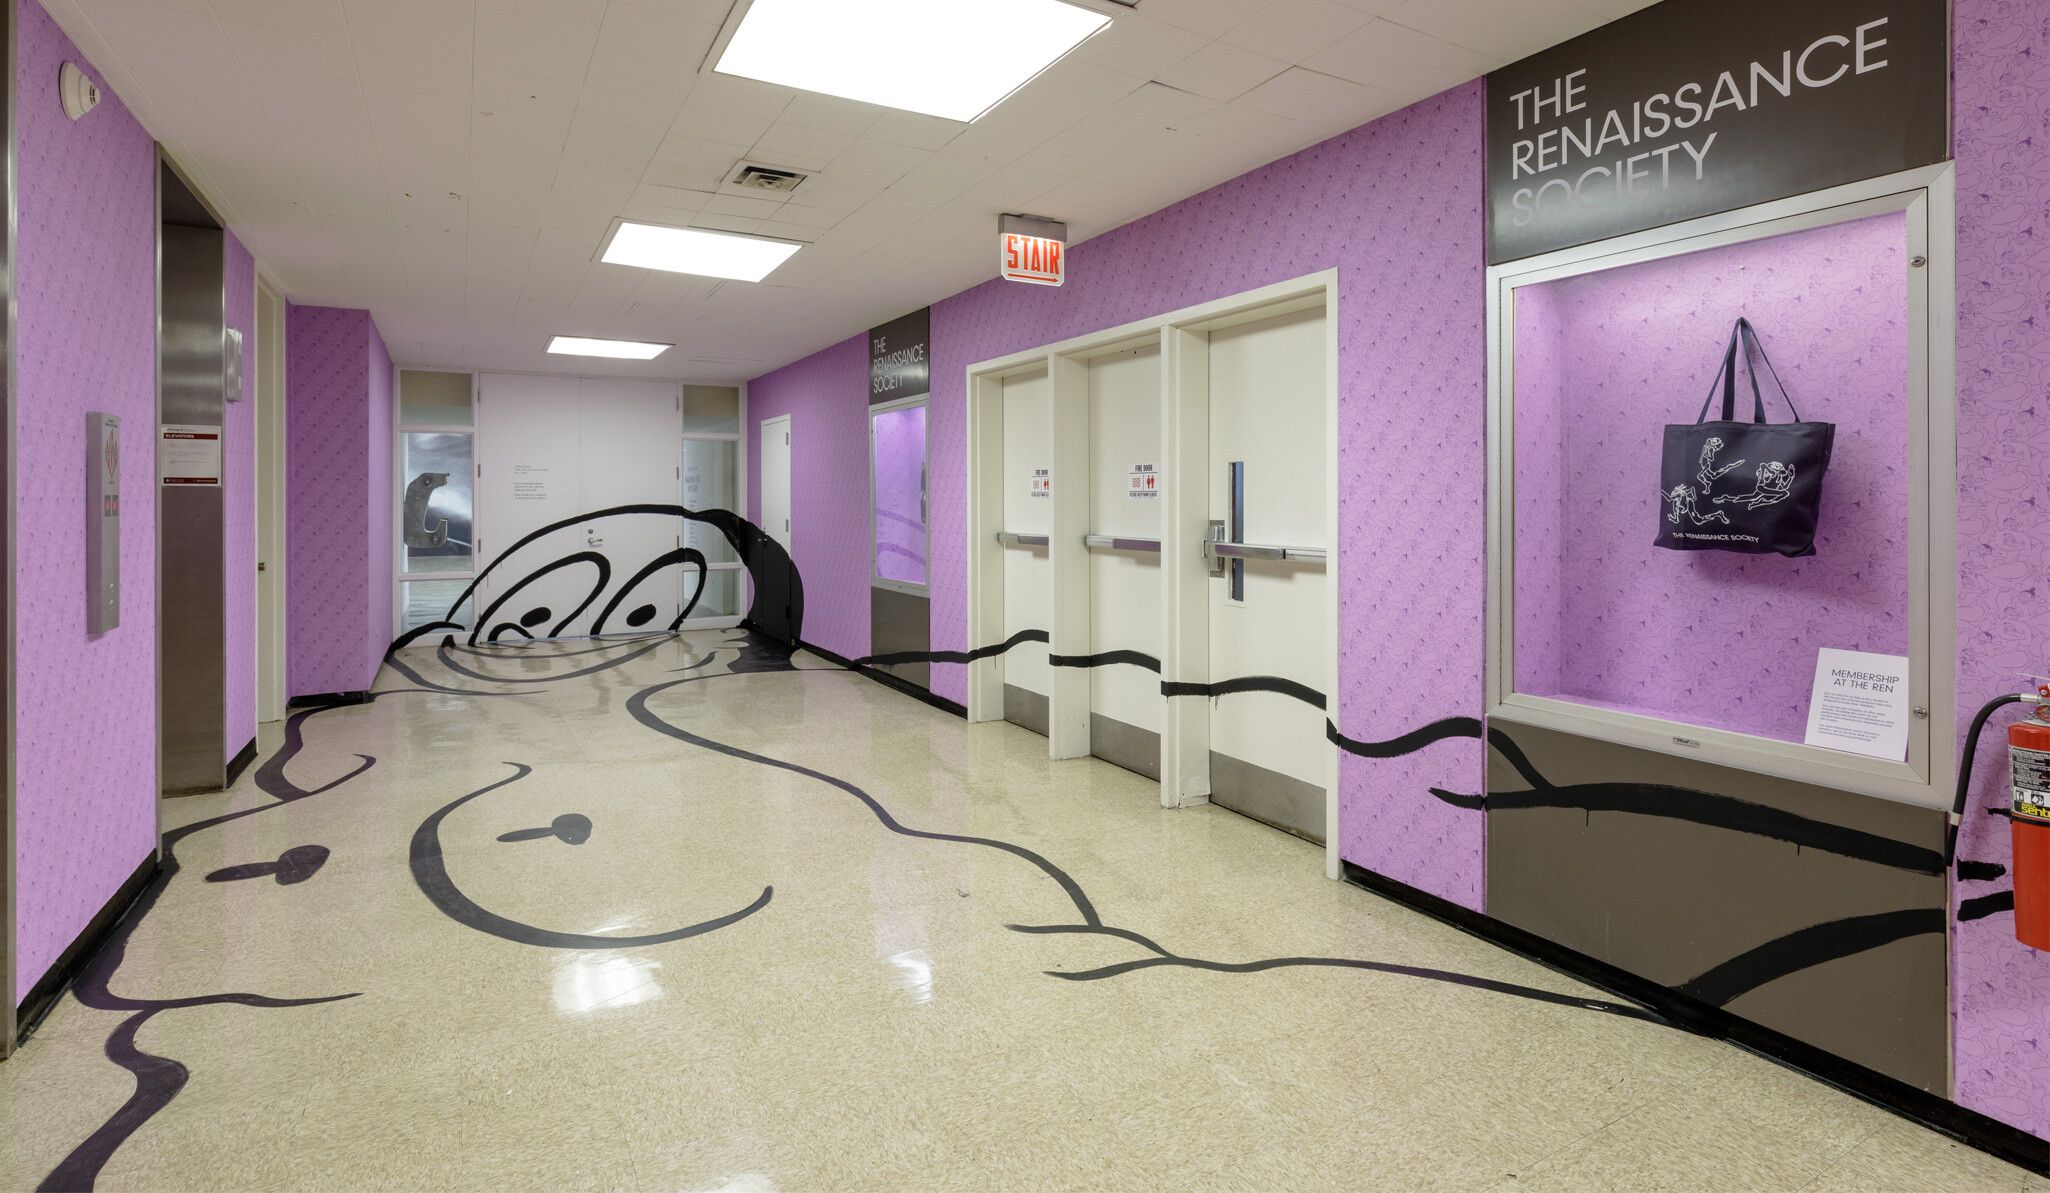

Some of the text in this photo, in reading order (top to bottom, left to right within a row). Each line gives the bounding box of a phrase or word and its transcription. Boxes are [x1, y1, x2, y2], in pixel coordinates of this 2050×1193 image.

[1510, 68, 1587, 131] THE
[1512, 16, 1889, 181] RENAISSANCE
[1512, 132, 1718, 228] SOCIETY
[1007, 235, 1060, 275] STAIR
[873, 336, 886, 355] THE
[873, 343, 924, 374] RENAISSANCE
[1730, 534, 1759, 543] SOCIETY
[1831, 669, 1900, 684] MEMBERSHIP
[1833, 678, 1894, 693] AT THE REN
